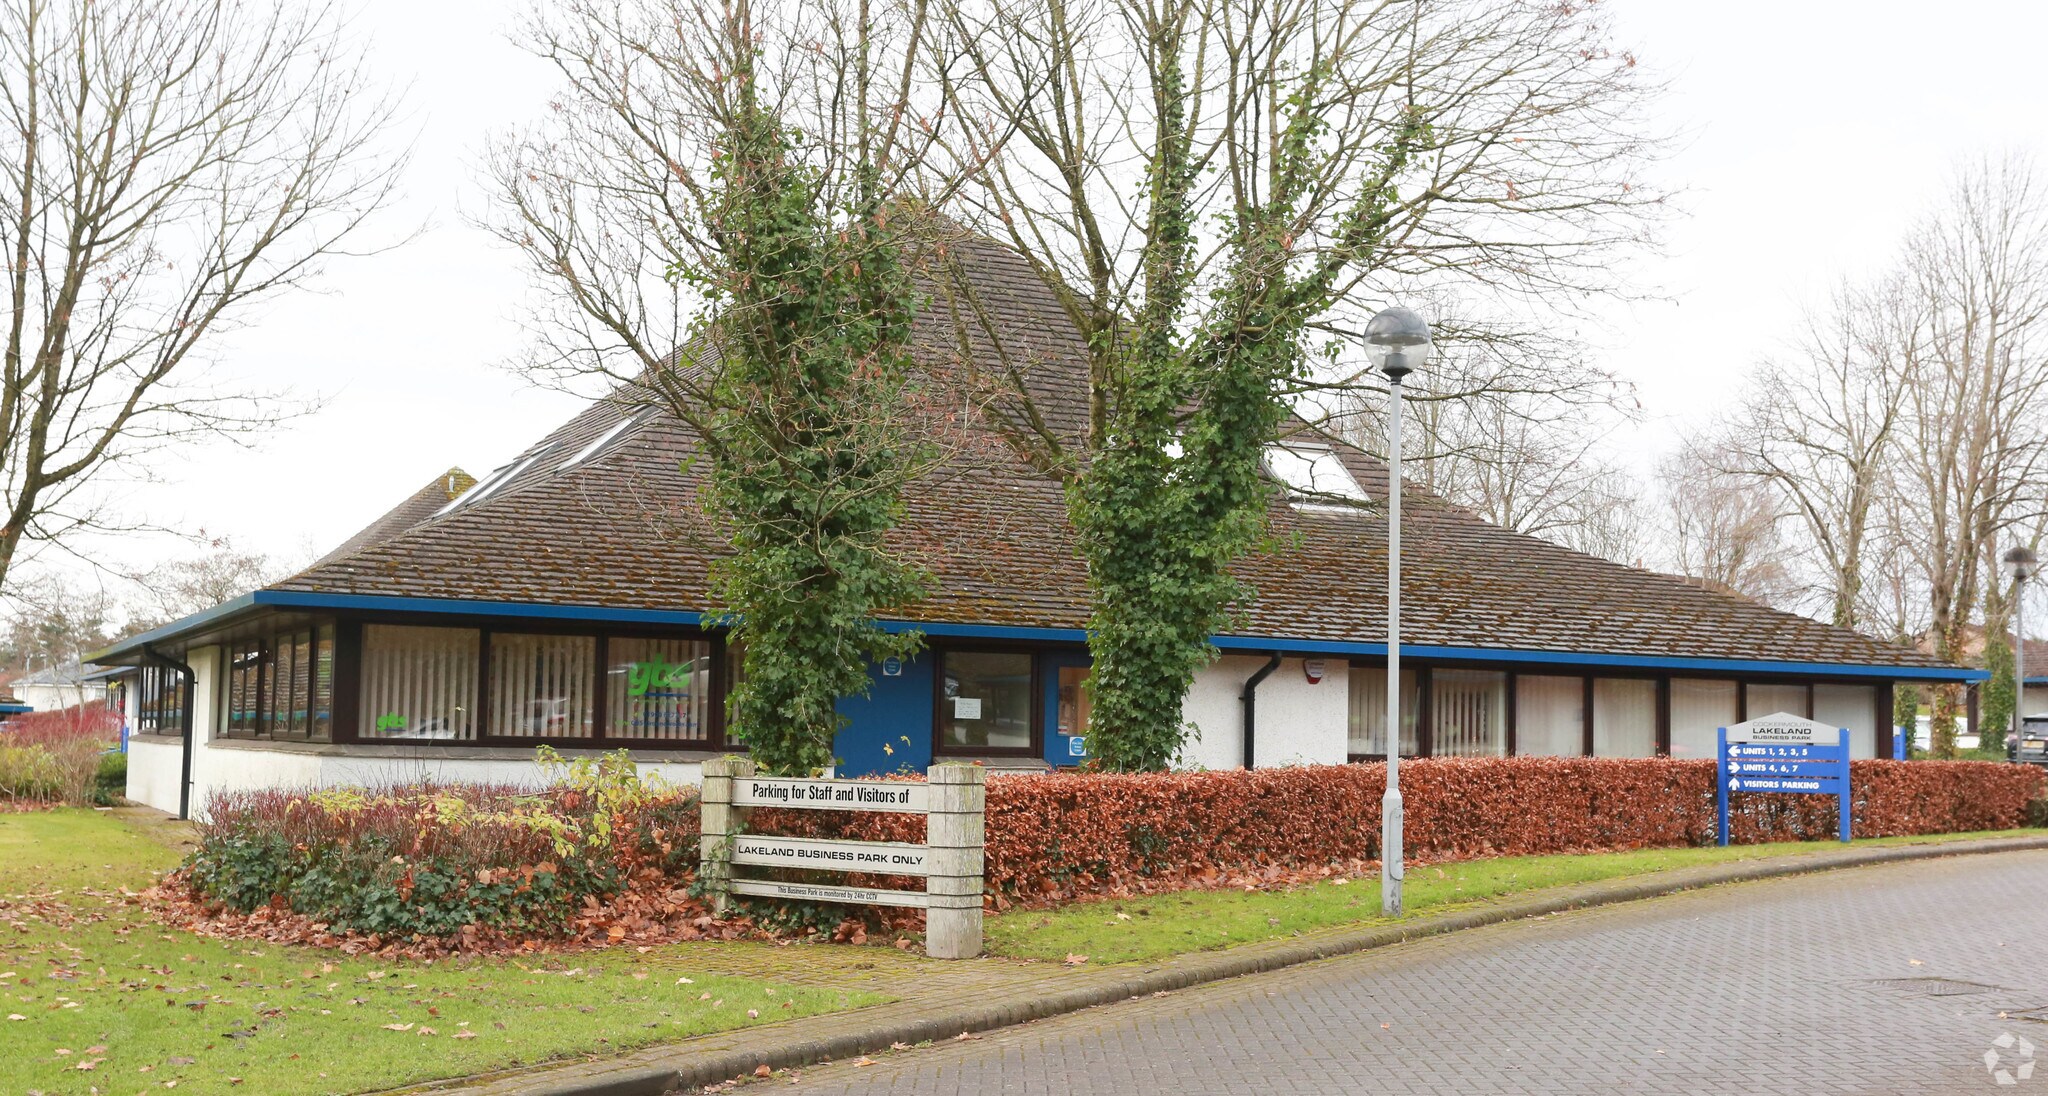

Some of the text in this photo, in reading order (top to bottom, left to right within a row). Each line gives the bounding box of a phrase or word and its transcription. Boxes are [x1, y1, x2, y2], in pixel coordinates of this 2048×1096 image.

[1768, 748, 1776, 756] 1,
[1778, 748, 1786, 756] 2,
[1790, 748, 1798, 756] 3,
[1768, 764, 1778, 772] 4,
[1780, 764, 1789, 773] 6,
[1782, 782, 1820, 790] PARKING
[752, 784, 910, 804] Parking for Staff and Visitors of
[738, 845, 923, 865] LAKELAND BUSINESS PARK ONLY
[788, 887, 806, 895] Business
[824, 890, 846, 898] monitored
